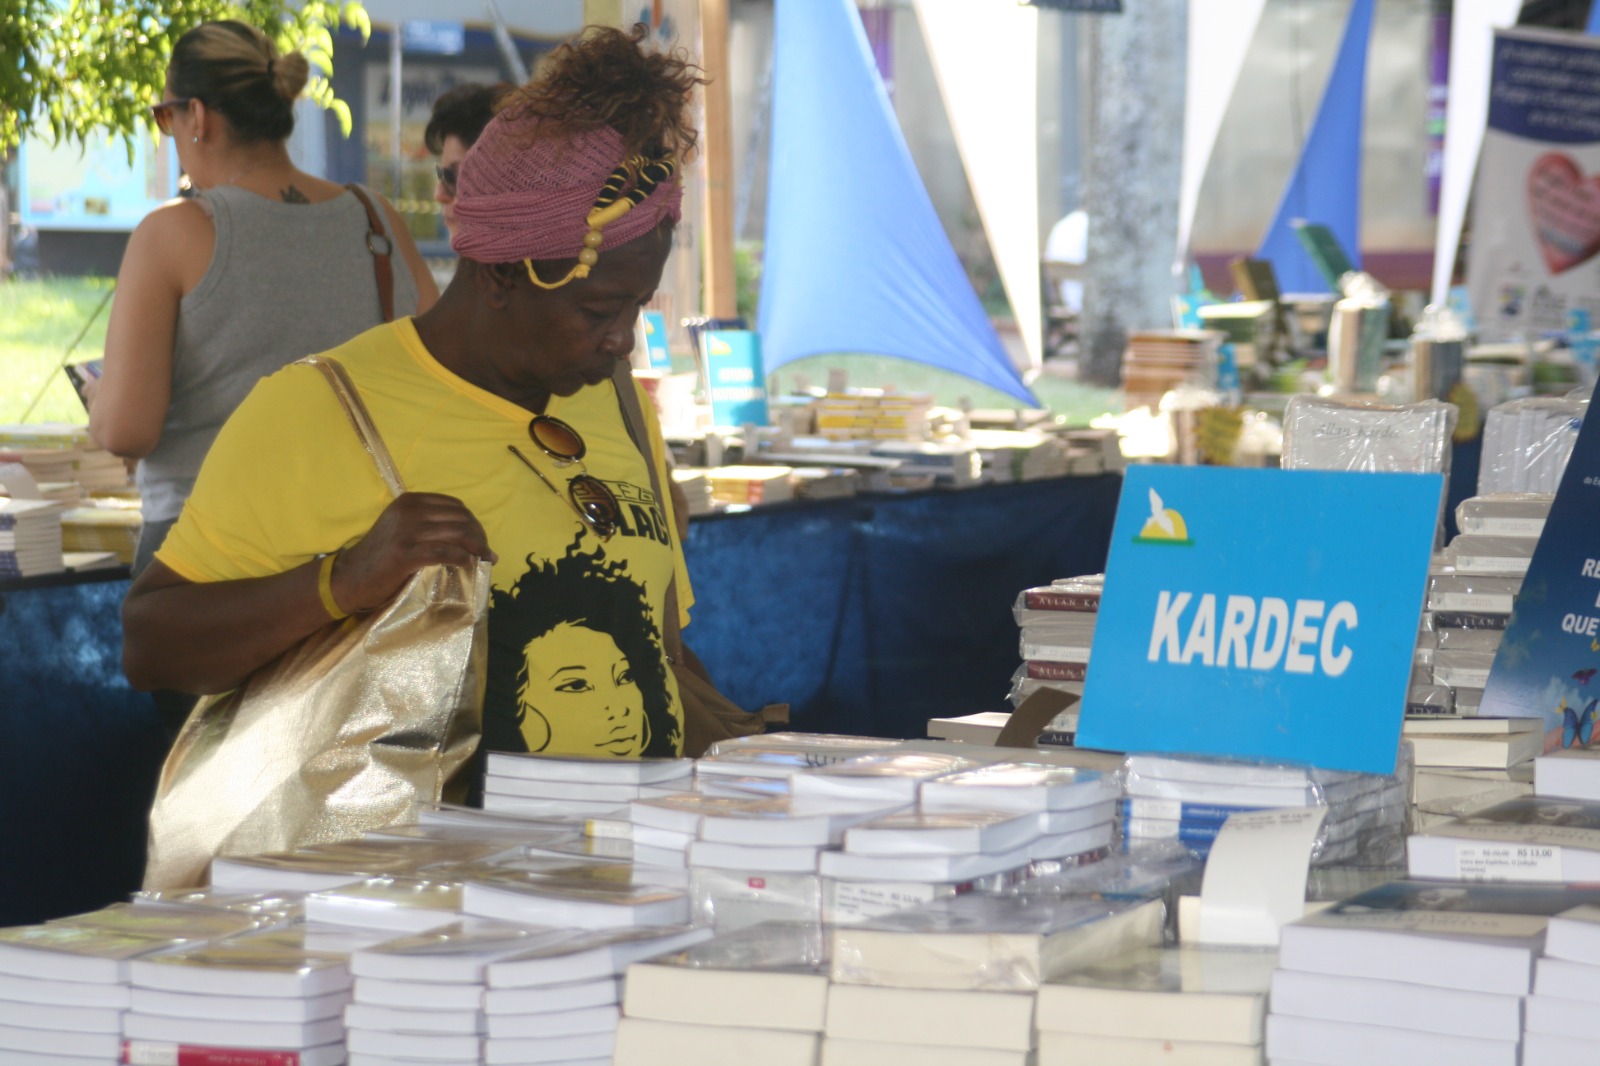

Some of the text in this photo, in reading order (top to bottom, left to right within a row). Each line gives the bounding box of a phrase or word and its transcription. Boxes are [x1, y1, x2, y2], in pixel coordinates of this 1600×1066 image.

[1040, 598, 1076, 606] ALLAN
[1455, 617, 1495, 626] ALLAN
[1561, 613, 1599, 636] QUE
[1148, 591, 1358, 678] KARDEC
[1039, 667, 1073, 676] ALLAN
[1517, 848, 1553, 858] R$ 13,00
